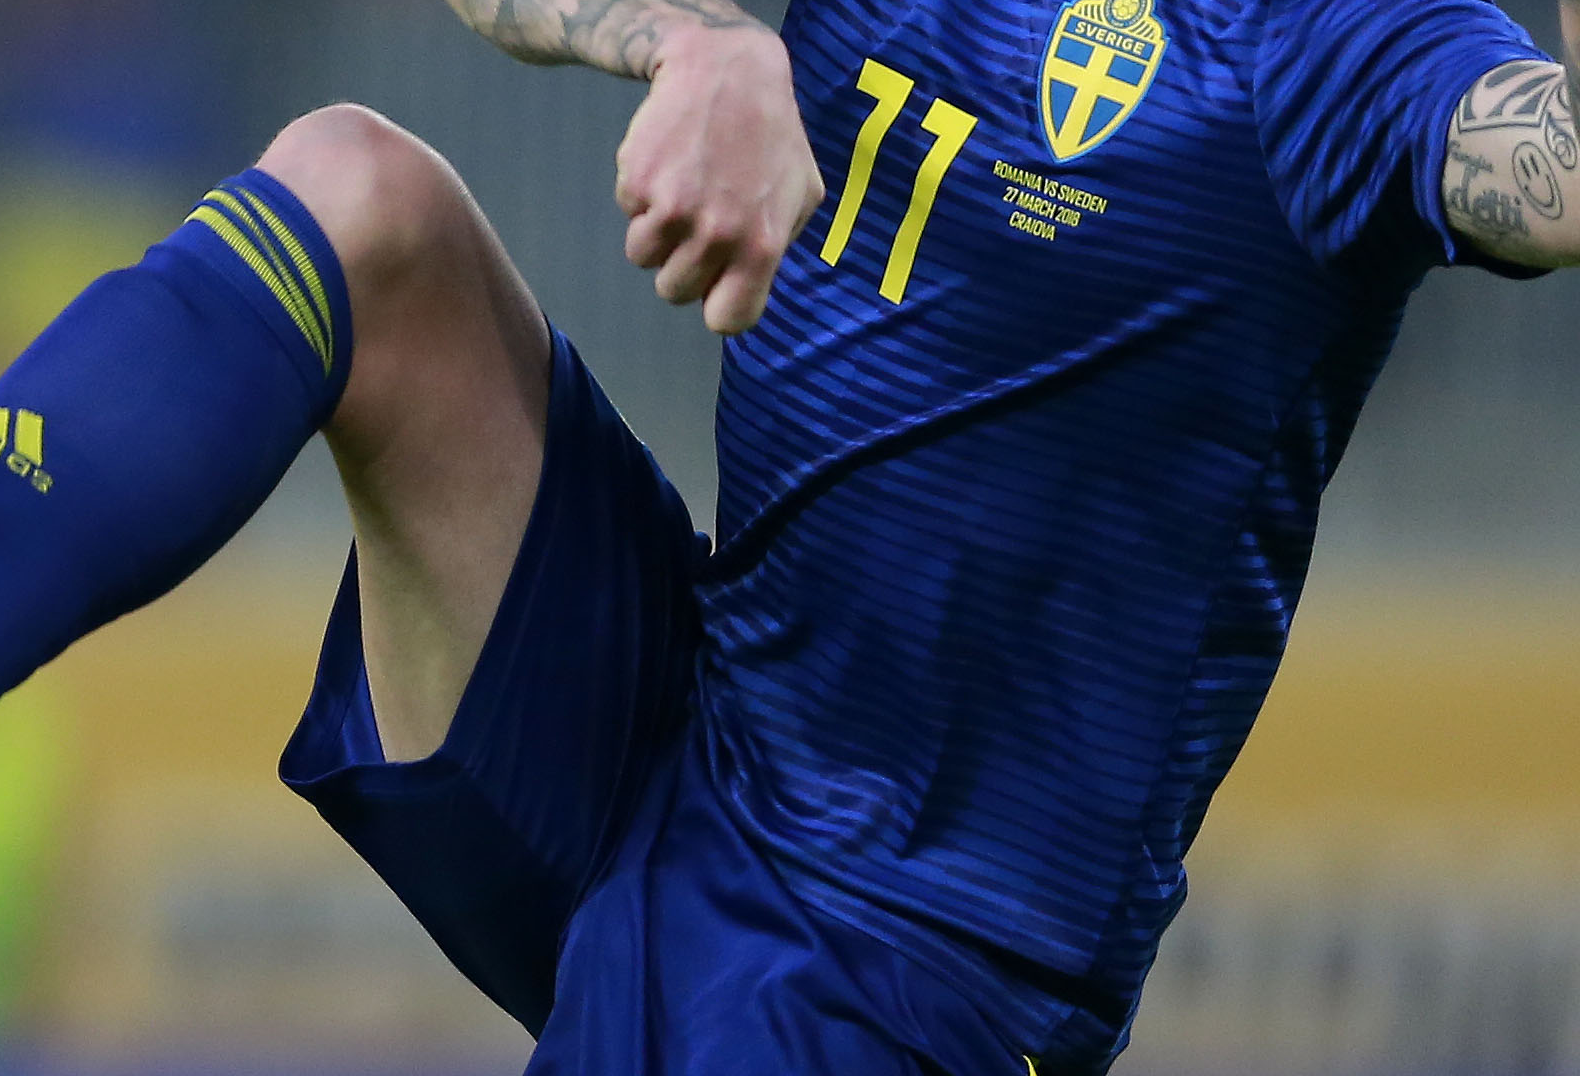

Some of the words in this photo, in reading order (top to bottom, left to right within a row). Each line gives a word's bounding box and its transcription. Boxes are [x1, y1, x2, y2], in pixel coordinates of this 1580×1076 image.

[1075, 21, 1146, 56] SVERIGE
[820, 58, 978, 305] 11
[993, 160, 1042, 192] ROMANIA
[1043, 178, 1059, 197] VS
[1057, 185, 1108, 214] SWEDEN
[1003, 186, 1019, 203] 27
[1016, 191, 1057, 220] MARCH
[1055, 206, 1081, 227] 2018
[1009, 211, 1057, 242] CRAIOVA
